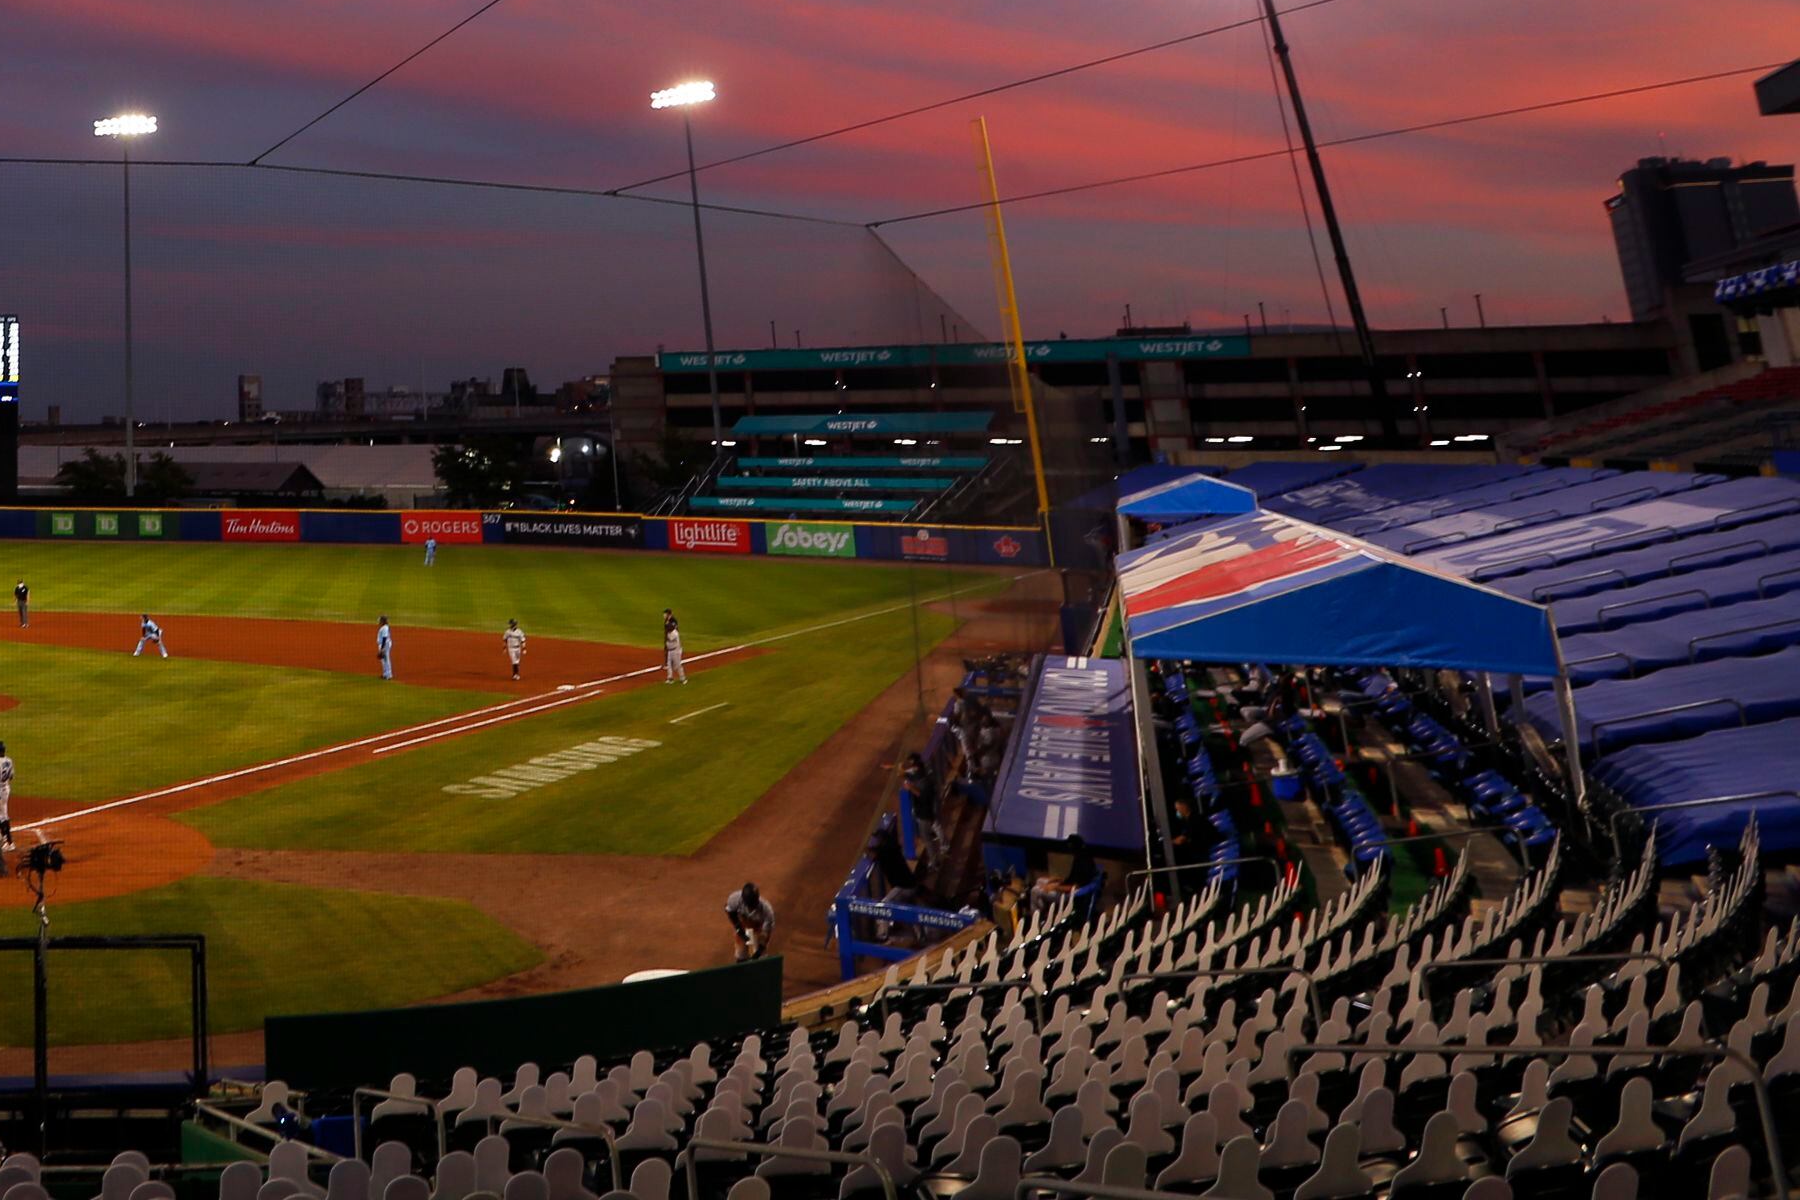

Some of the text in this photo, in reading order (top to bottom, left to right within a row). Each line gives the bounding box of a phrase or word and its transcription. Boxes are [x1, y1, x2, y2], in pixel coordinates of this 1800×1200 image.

[1139, 341, 1205, 356] WESTJET
[820, 351, 877, 366] WESTJET
[826, 421, 866, 432] WESTJET
[792, 478, 871, 487] SAFETY ABOVE ALL
[226, 517, 295, 534] Tim Hortons
[482, 514, 501, 524] 367
[422, 521, 479, 534] ROGERS
[519, 523, 622, 537] BLACK LIVES MATTER
[771, 523, 850, 553] Sobeys
[440, 735, 663, 799] SAMSUNG
[1016, 759, 1114, 809] JAYS
[848, 902, 893, 917] SAMSUNG
[918, 914, 964, 929] SAMSUNG
